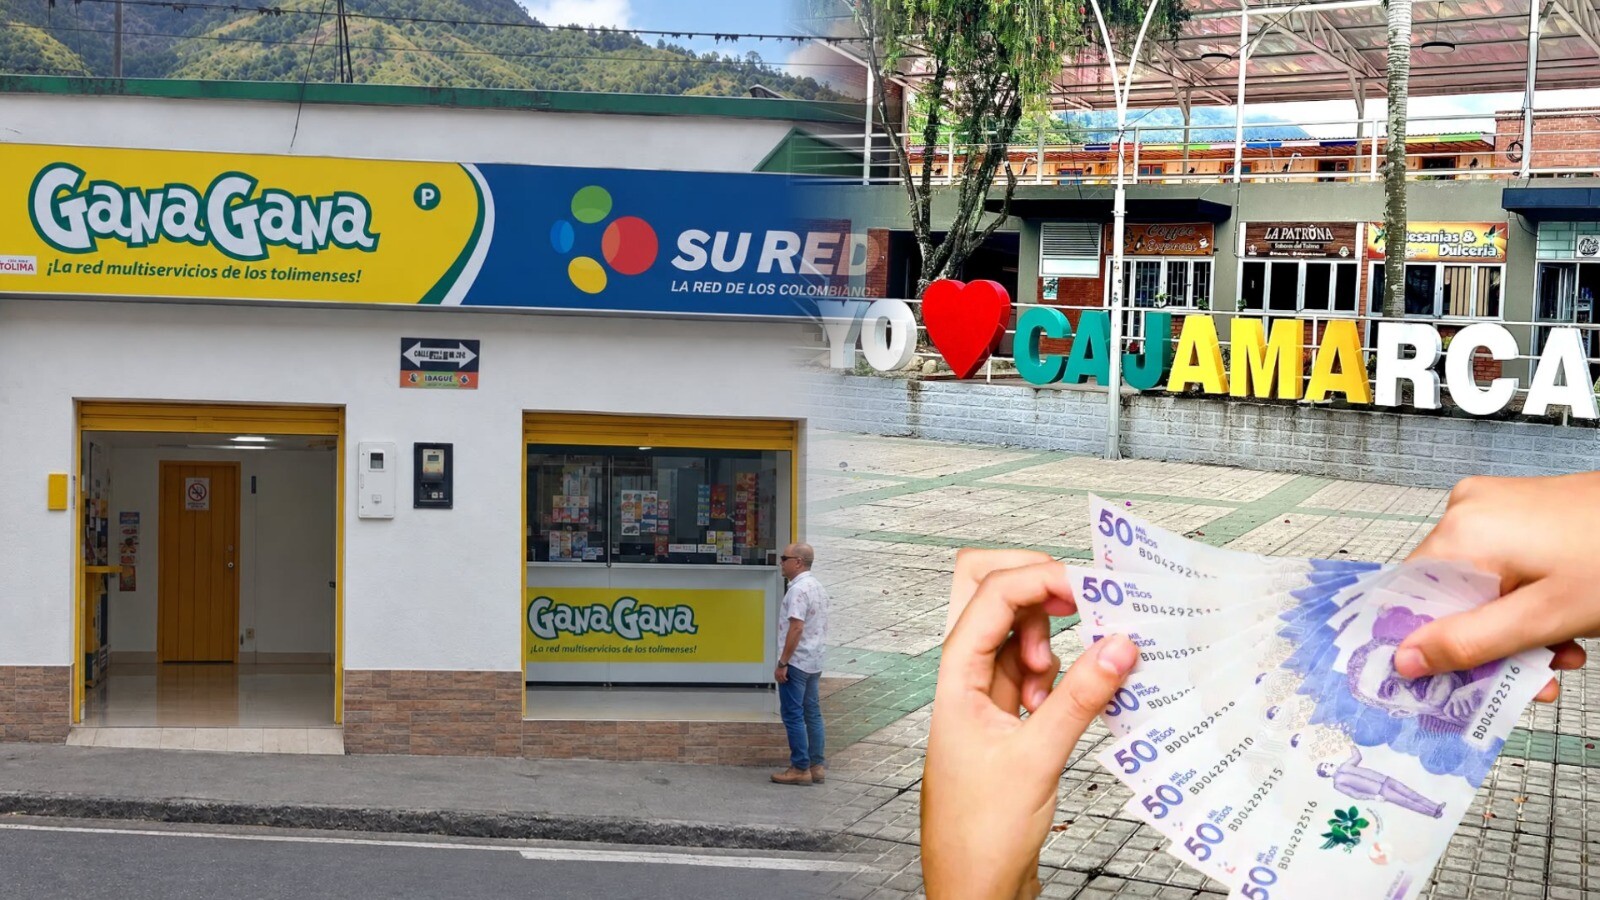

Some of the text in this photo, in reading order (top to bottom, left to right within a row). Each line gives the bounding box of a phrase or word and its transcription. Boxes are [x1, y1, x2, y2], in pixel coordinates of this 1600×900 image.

[421, 189, 434, 205] P
[1146, 224, 1196, 240] Coffee
[1264, 227, 1279, 239] LA
[1406, 230, 1476, 243] tesanias &
[671, 229, 880, 277] SU RED
[0, 263, 34, 271] TOLIMA
[47, 259, 362, 283] ¡La red multiservicios de los tolimenses!
[671, 281, 880, 298] LA RED DE LOS COLOMBIANOS
[816, 299, 1600, 419] YO CAJAMARCA
[1098, 508, 1133, 546] 50
[1135, 526, 1147, 535] MIL
[1135, 533, 1158, 549] PESOS
[1082, 576, 1124, 606] 50
[1124, 582, 1138, 590] MIL
[1126, 590, 1152, 599] PESOS
[1132, 603, 1221, 617] BD042925
[530, 645, 697, 654] ¡La red multiservicios de los tolimenses!
[1131, 682, 1145, 691] MIL
[1136, 685, 1160, 698] PESOS
[1473, 665, 1520, 740] BD04292516
[1146, 728, 1161, 739] MIL
[1152, 727, 1176, 745] PESOS
[1114, 739, 1158, 775] 50
[1189, 736, 1255, 795] BD04292510
[1169, 772, 1182, 783] MIL
[1175, 769, 1197, 787] PESOS
[1141, 784, 1184, 819] 50
[1228, 767, 1284, 832] BD04292515
[1207, 809, 1220, 821] MIL
[1214, 805, 1233, 825] PESOS
[1184, 822, 1224, 862] 50
[1277, 800, 1318, 870] BD04292516
[1256, 852, 1266, 863] MIL
[1264, 845, 1279, 866] PESOS
[1241, 866, 1278, 900] 50
